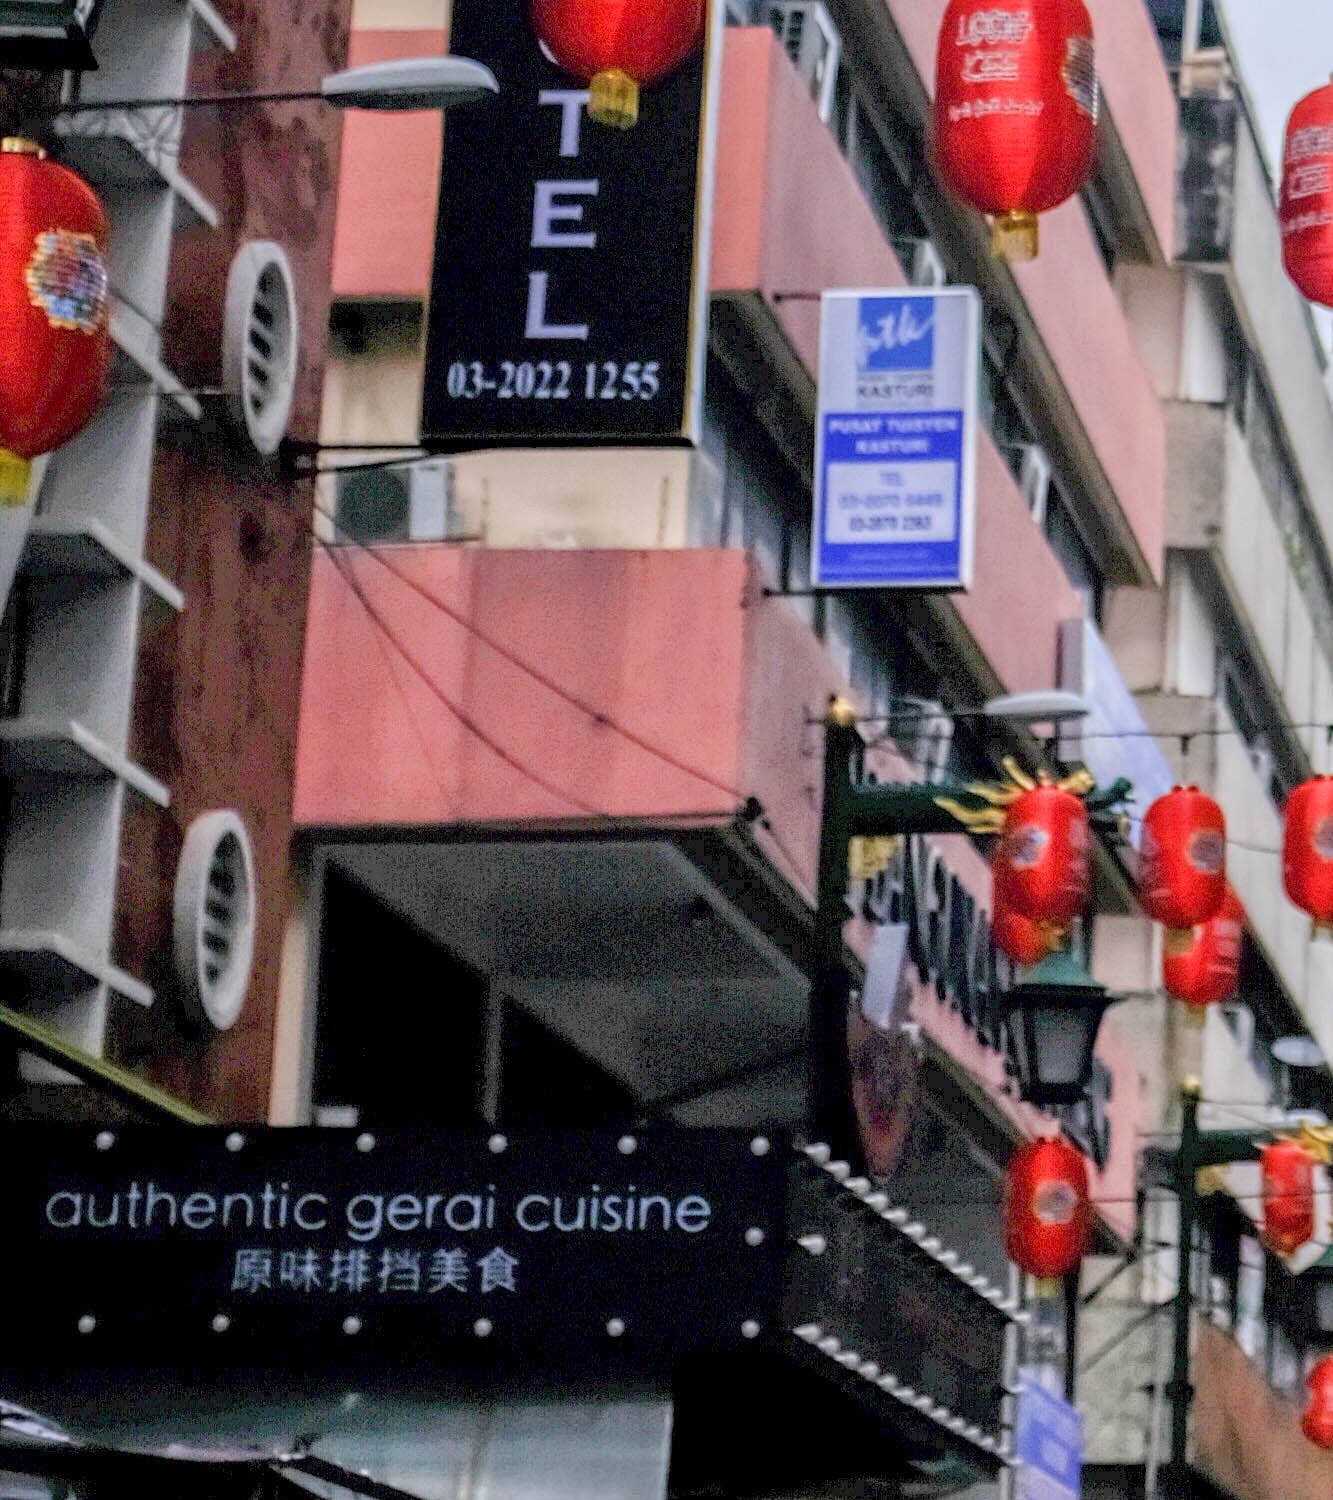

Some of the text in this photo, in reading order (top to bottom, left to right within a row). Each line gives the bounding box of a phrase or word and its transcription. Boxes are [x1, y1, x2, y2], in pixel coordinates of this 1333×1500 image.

[961, 50, 1019, 83] KEE
[446, 358, 661, 401] 03-2022 1255
[45, 1180, 714, 1242] authentic gerai cuisine
[230, 1245, 520, 1294] 原味排挡美食
